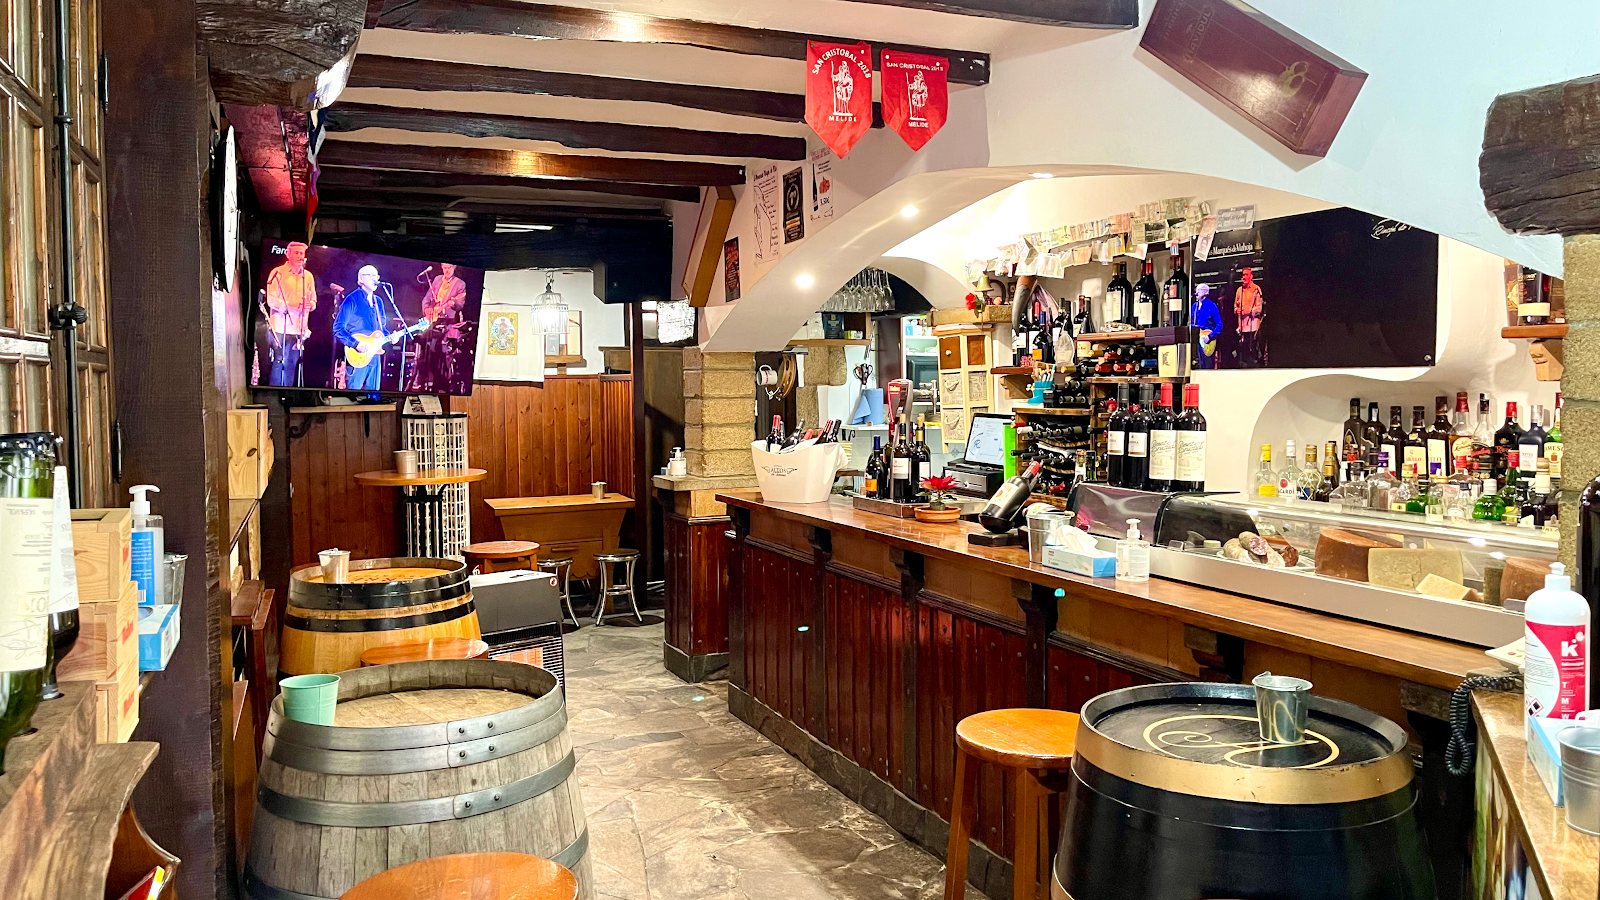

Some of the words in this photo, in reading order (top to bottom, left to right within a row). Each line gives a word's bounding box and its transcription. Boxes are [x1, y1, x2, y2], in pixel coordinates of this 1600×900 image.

[812, 58, 825, 75] SAN
[822, 48, 857, 64] CRISTOBAL
[857, 60, 872, 79] 2018
[899, 62, 930, 71] CRISTOBAL
